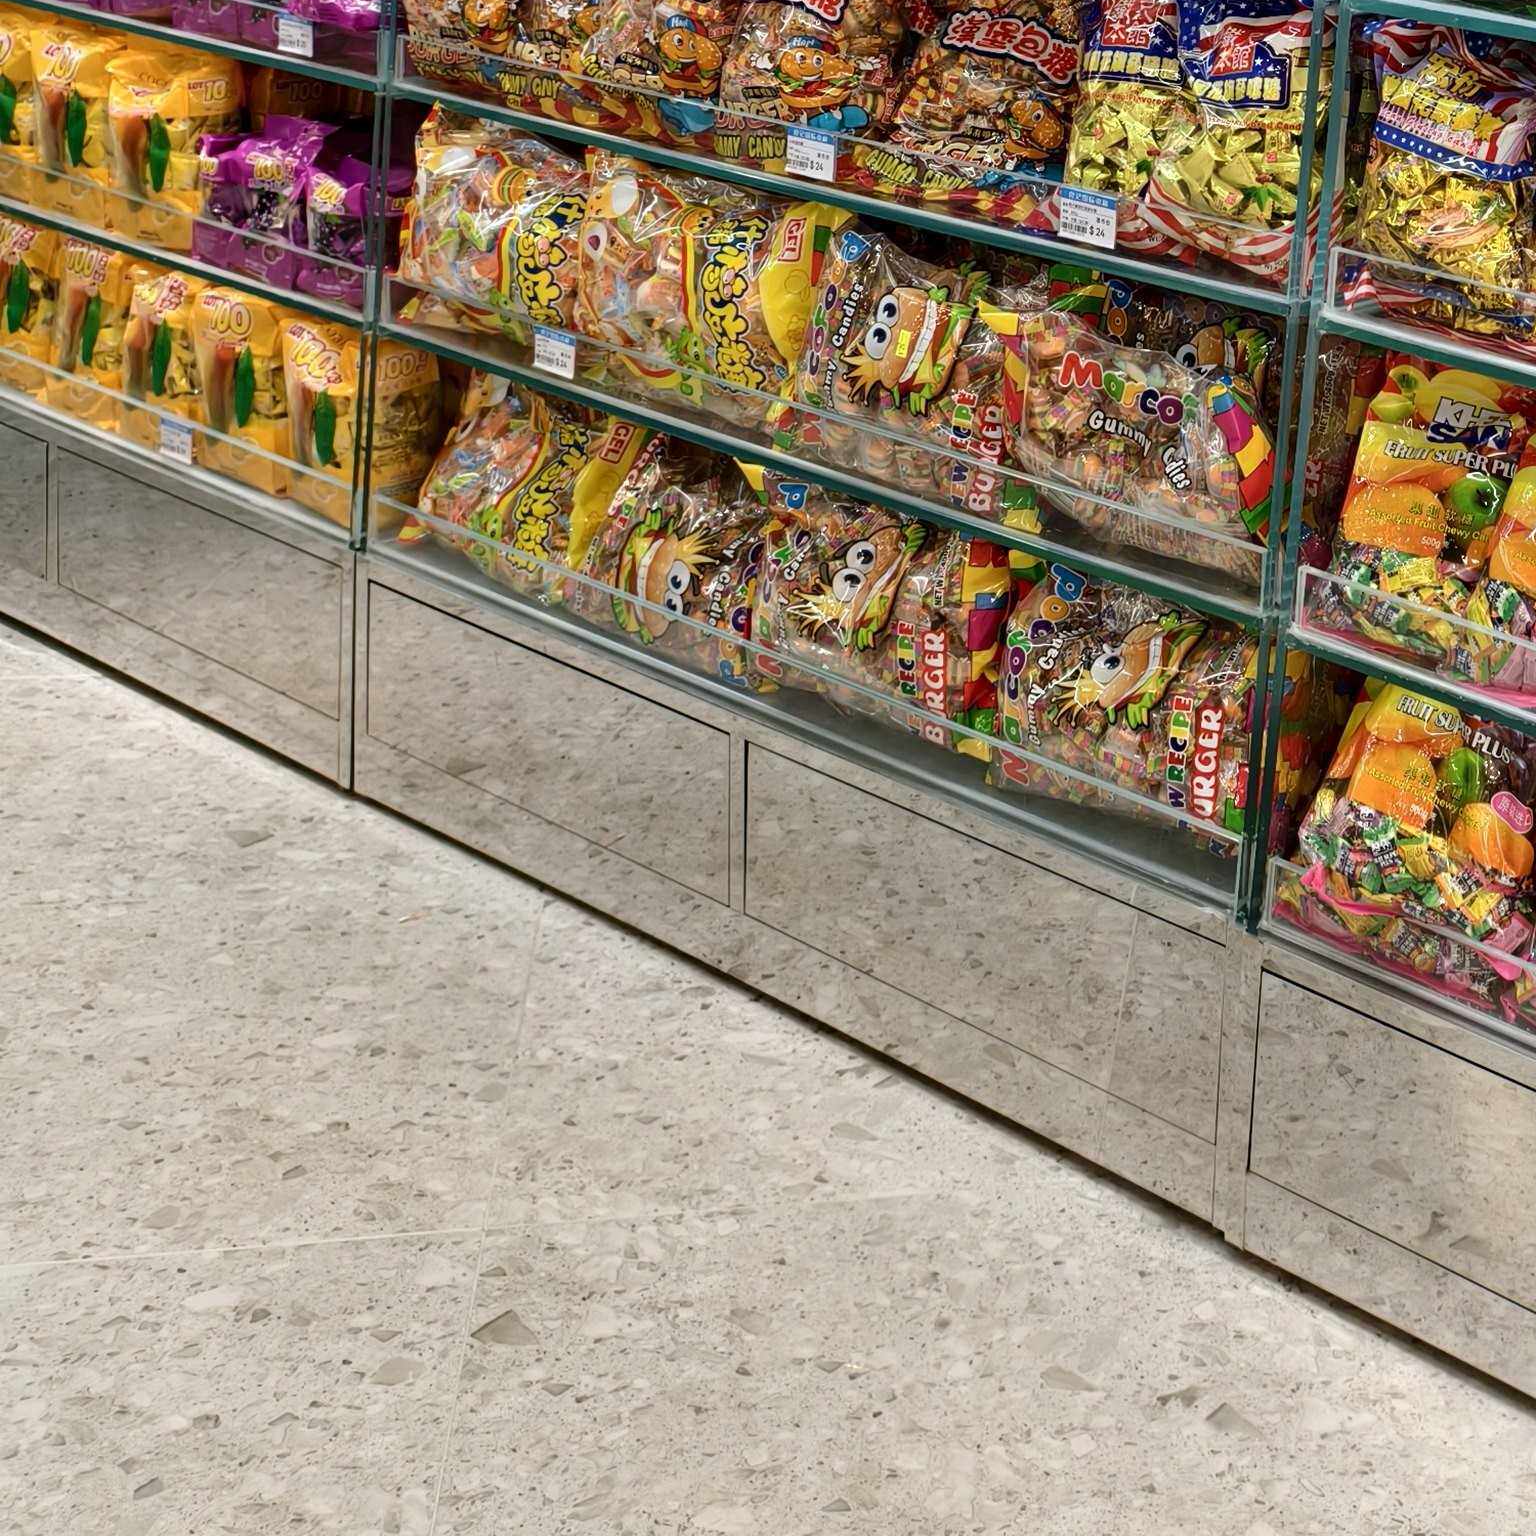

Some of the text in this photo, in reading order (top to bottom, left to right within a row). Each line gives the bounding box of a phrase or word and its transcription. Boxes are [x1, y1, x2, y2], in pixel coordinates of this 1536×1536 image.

[782, 219, 804, 262] GEL
[1096, 227, 1105, 239] 24
[210, 304, 253, 334] 100
[832, 282, 864, 349] Candies
[601, 423, 633, 463] GEL
[1088, 410, 1152, 458] Gummy
[1384, 439, 1488, 472] FRUIT SUPER
[1396, 695, 1433, 722] FRUIT
[1472, 733, 1511, 764] PLUS
